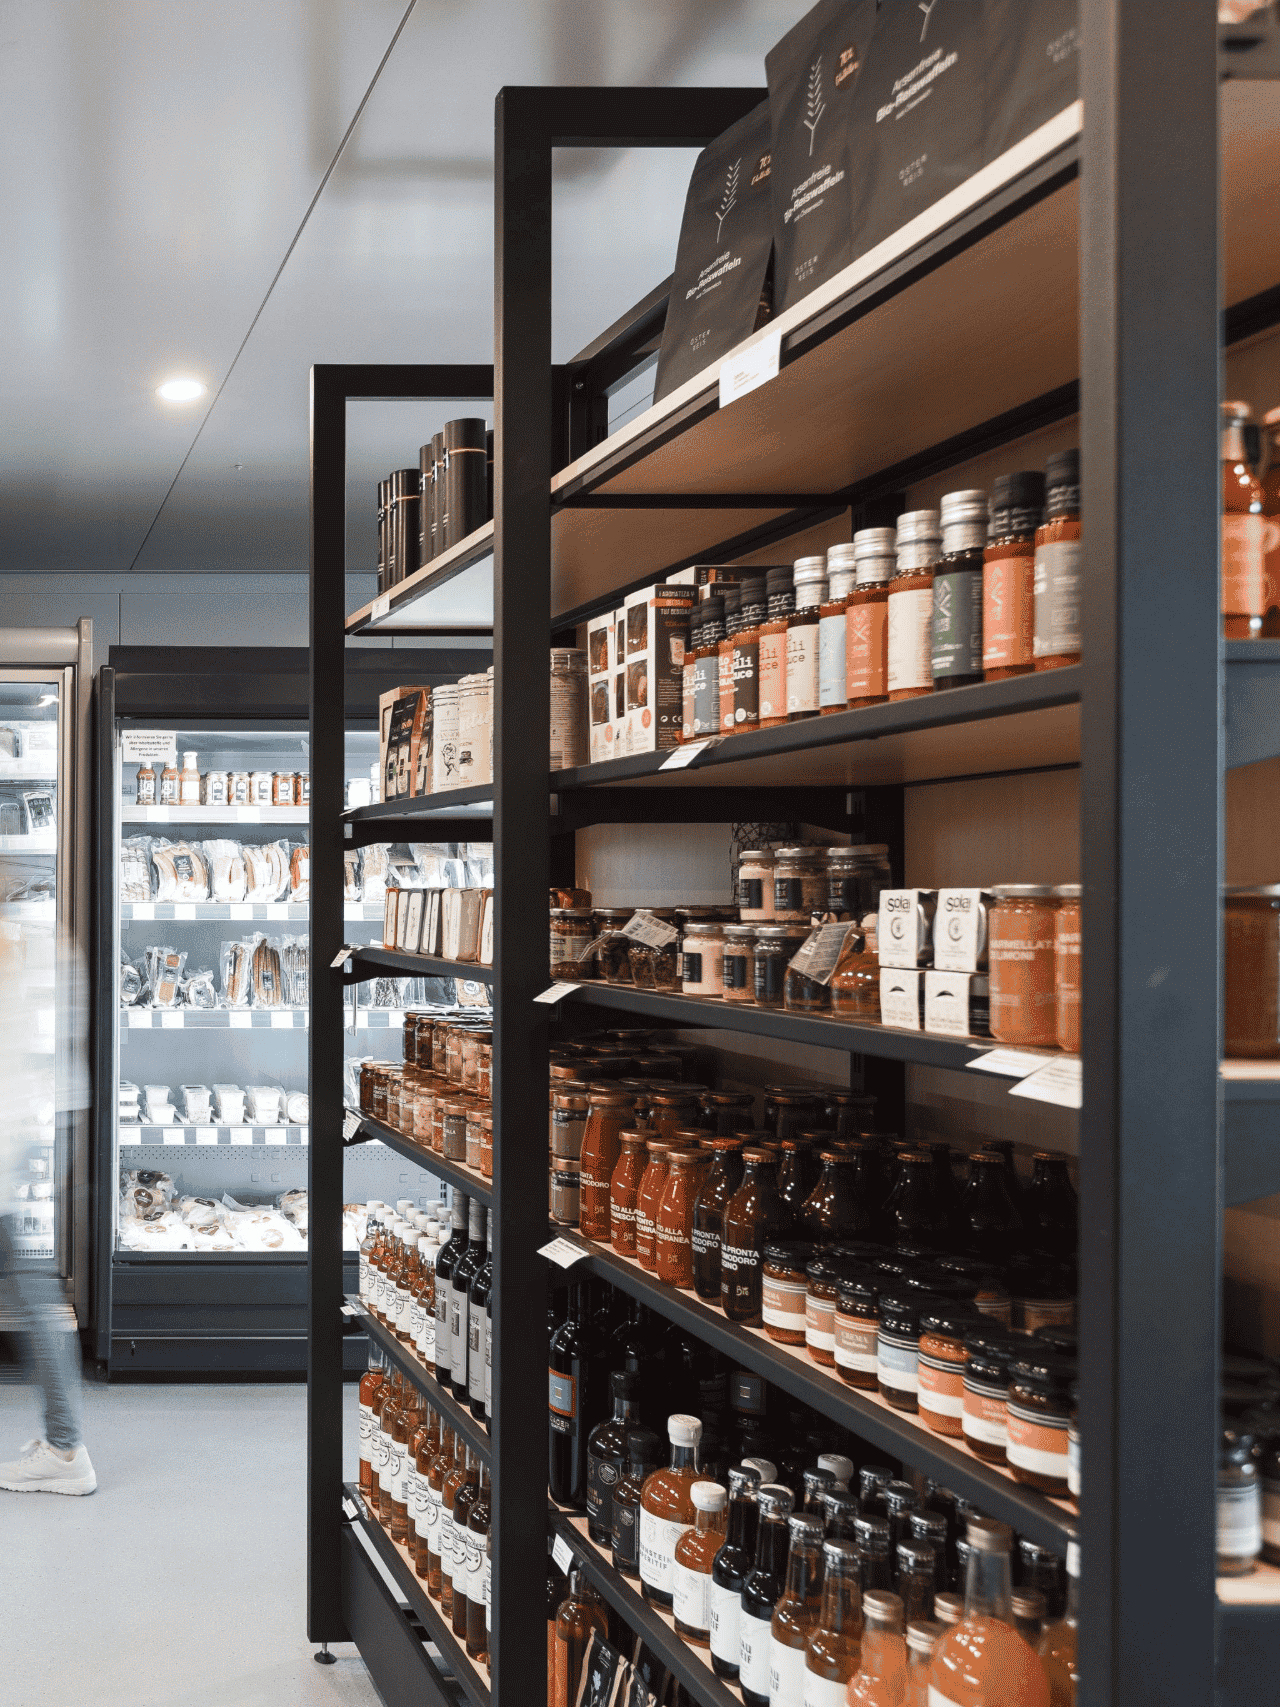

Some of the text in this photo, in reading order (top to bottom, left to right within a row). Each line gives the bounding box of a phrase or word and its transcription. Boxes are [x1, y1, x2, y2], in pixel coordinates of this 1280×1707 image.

[891, 48, 943, 95] Arsenfreie
[876, 52, 958, 124] Bio-Reiswaffeln
[898, 153, 927, 180] ÖSTER
[903, 167, 924, 187] REIS
[790, 164, 832, 201] Arsenfreie
[698, 251, 731, 281] Arsenfreie
[795, 255, 819, 276] ÖSTER
[798, 266, 815, 282] REIS
[685, 257, 741, 300] Bio-Reiswaffeln
[690, 329, 711, 346] ÖSTER
[693, 1228, 721, 1241] PRONTA
[727, 1245, 760, 1259] PRONTA
